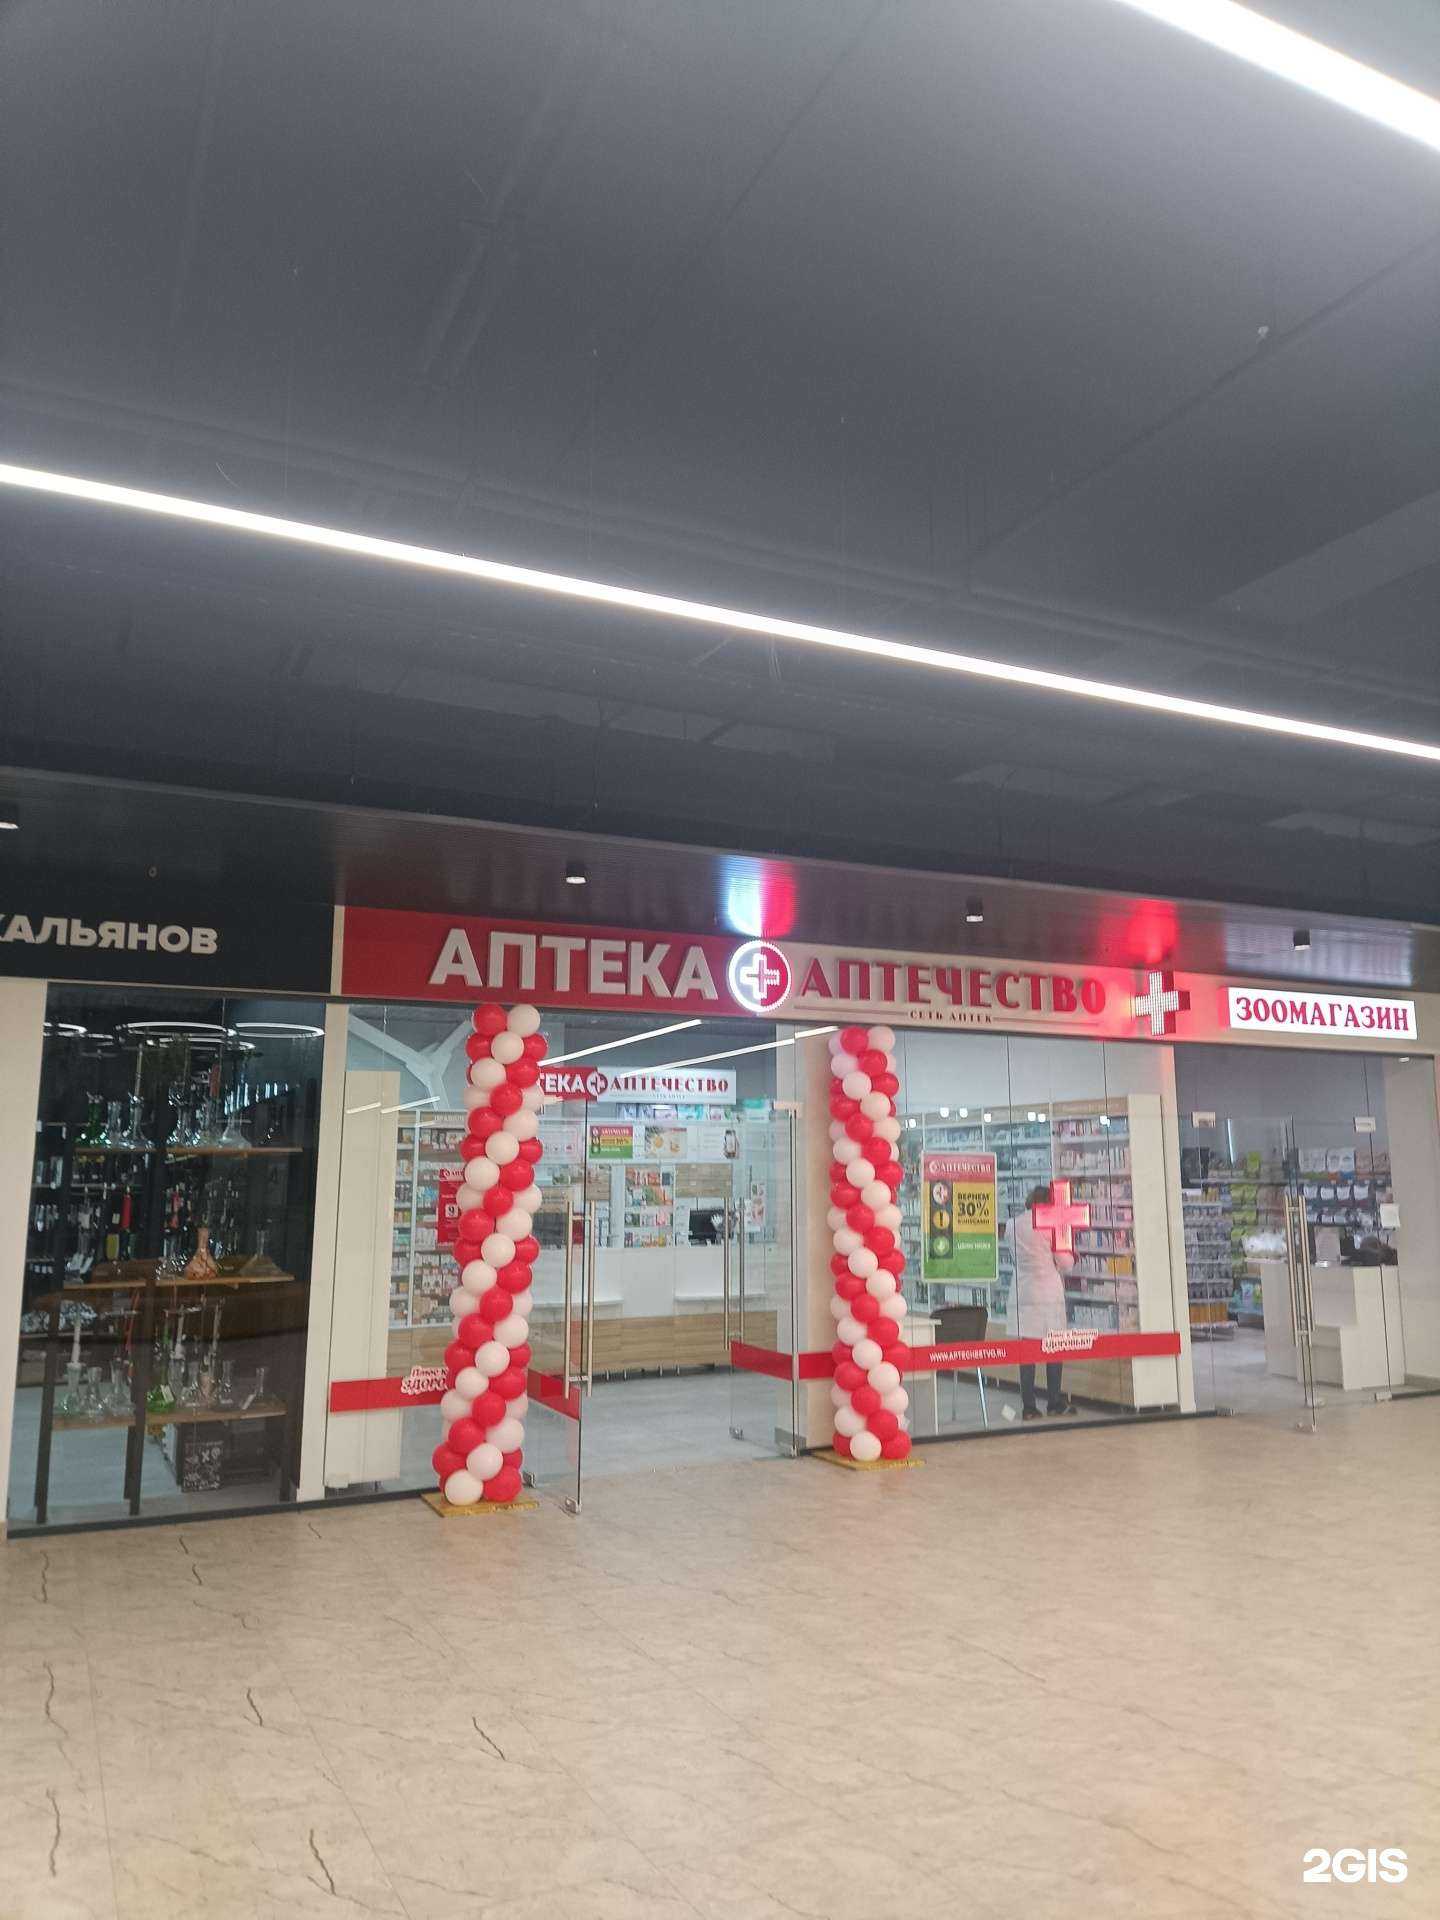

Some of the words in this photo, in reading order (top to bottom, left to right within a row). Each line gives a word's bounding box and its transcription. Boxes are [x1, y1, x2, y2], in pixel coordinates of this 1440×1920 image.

[0, 914, 218, 954] АЛЬЯНОВ
[428, 928, 719, 1000] АПТЕКА
[801, 957, 1107, 1015] АПТЕЧЕСТВО
[910, 1010, 943, 1021] СЕТЬ
[950, 1012, 992, 1024] АПТЕК
[1236, 997, 1409, 1031] ЗООМАГАЗИН
[958, 1202, 989, 1217] 30%
